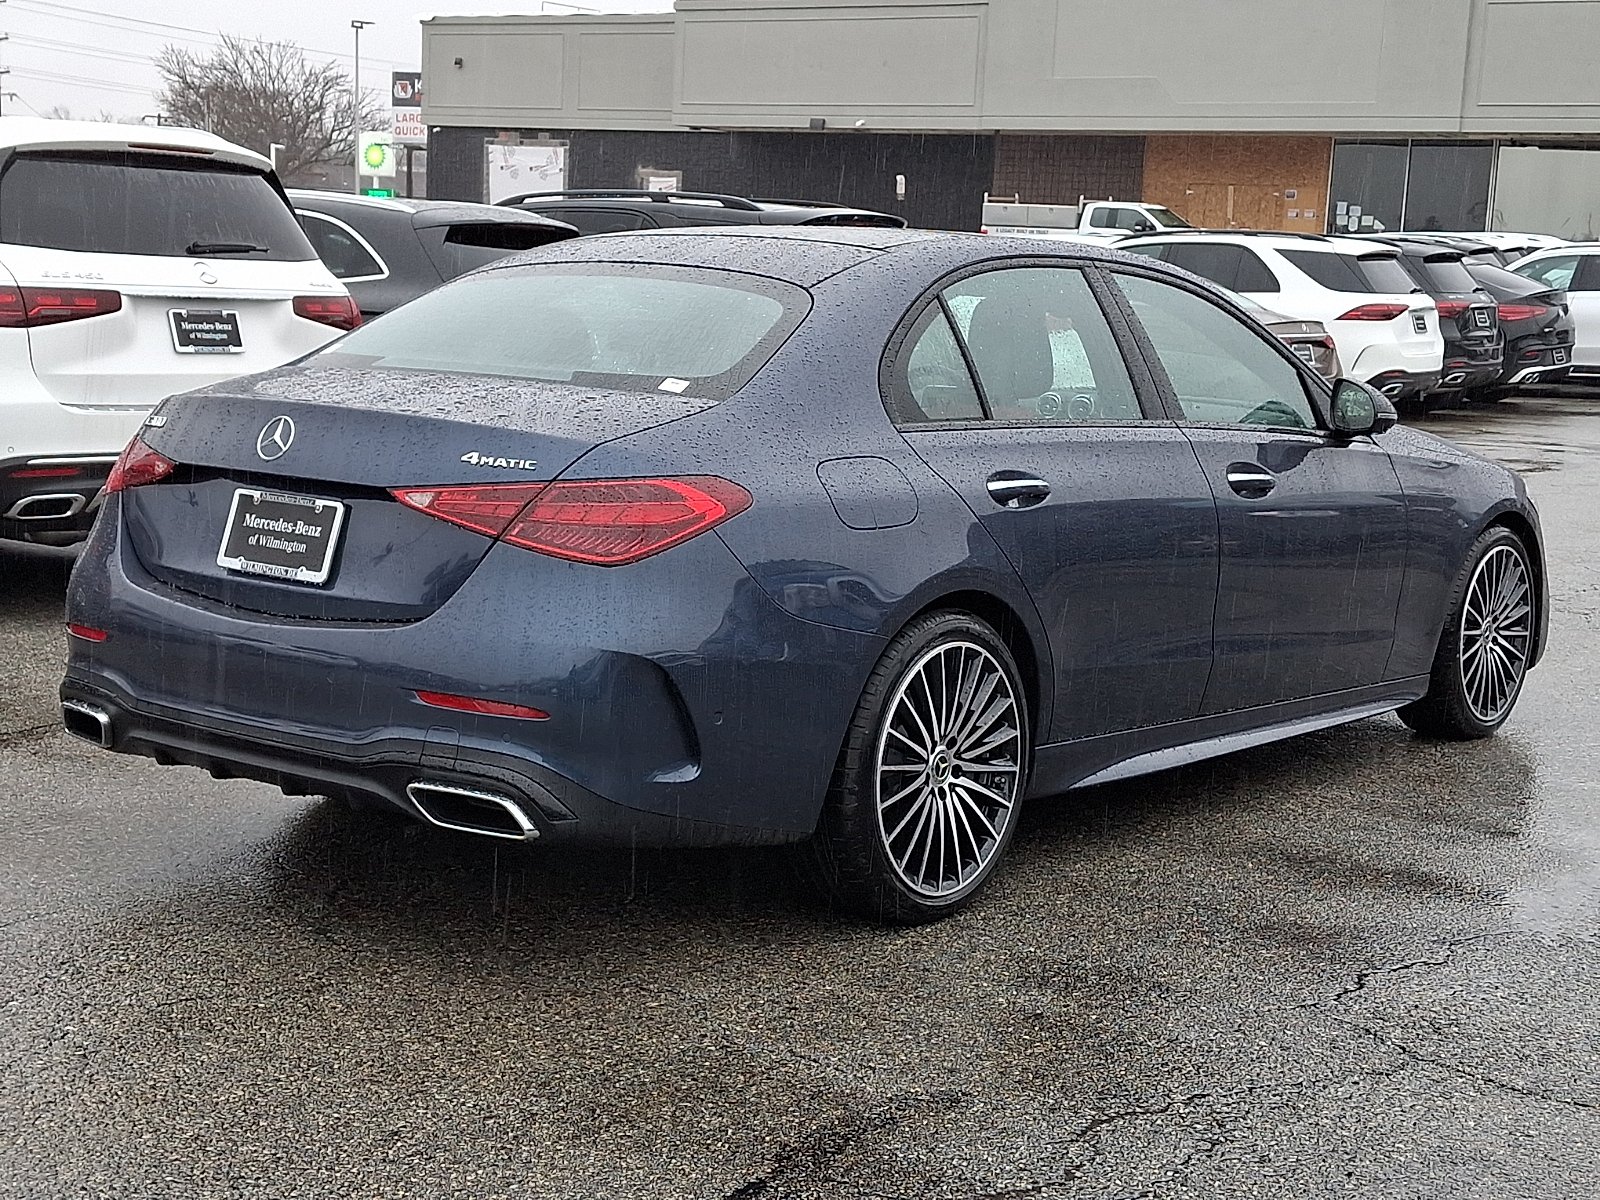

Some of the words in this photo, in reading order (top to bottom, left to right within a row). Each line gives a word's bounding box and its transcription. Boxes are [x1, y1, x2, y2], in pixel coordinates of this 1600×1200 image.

[395, 126, 425, 136] QUICK
[180, 321, 233, 331] Mercedes-Benz
[460, 451, 538, 471] 4MATIC
[243, 513, 322, 537] Mercedes-Benz
[248, 534, 259, 546] of
[259, 535, 306, 553] Wilmington
